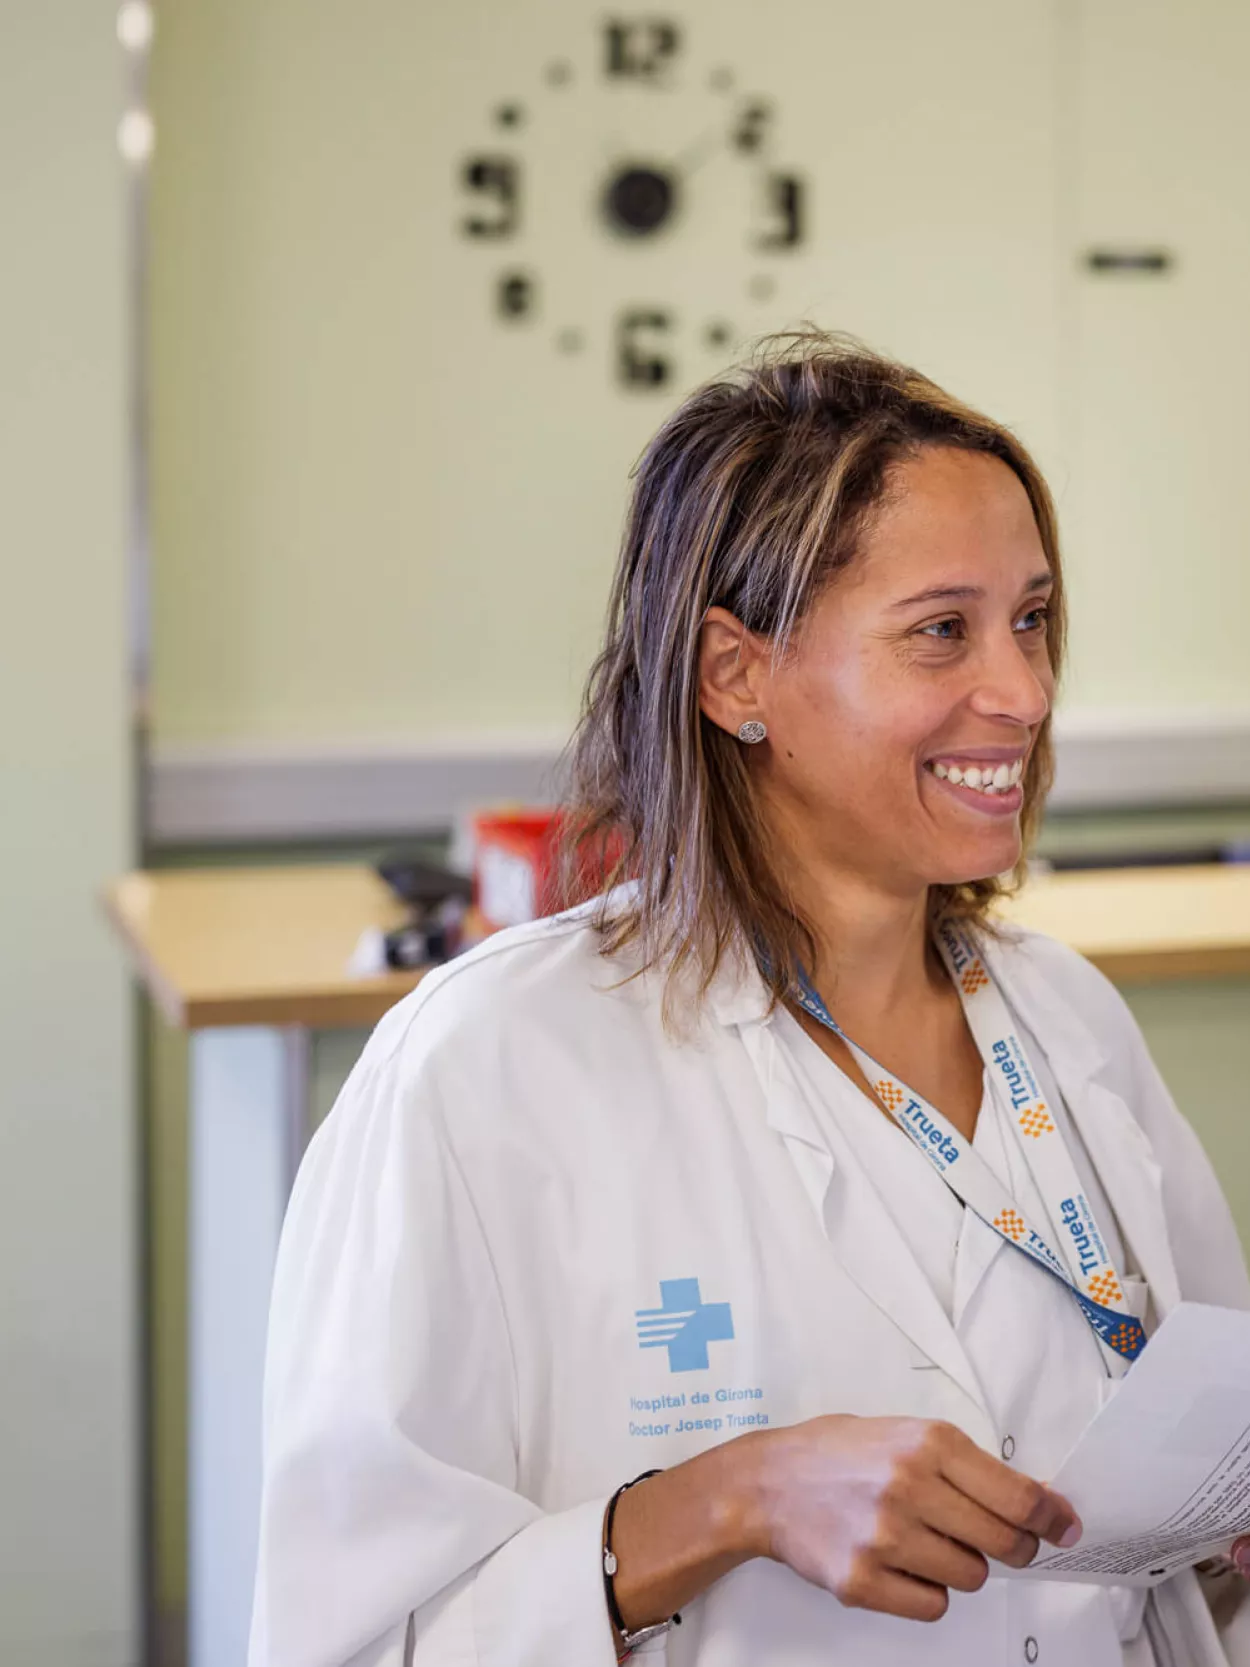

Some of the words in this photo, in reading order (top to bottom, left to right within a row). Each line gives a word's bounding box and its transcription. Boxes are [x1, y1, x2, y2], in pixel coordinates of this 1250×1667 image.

[603, 14, 682, 86] 12
[461, 154, 519, 241] 9
[752, 172, 806, 254] 3
[617, 307, 673, 390] 6
[992, 1040, 1030, 1110] Trueta
[904, 1098, 959, 1164] Trueta
[1060, 1198, 1098, 1276] Trueta
[675, 1416, 722, 1433] Josep
[726, 1412, 769, 1427] Trueta
[691, 1391, 710, 1405] de
[715, 1387, 763, 1402] Girona
